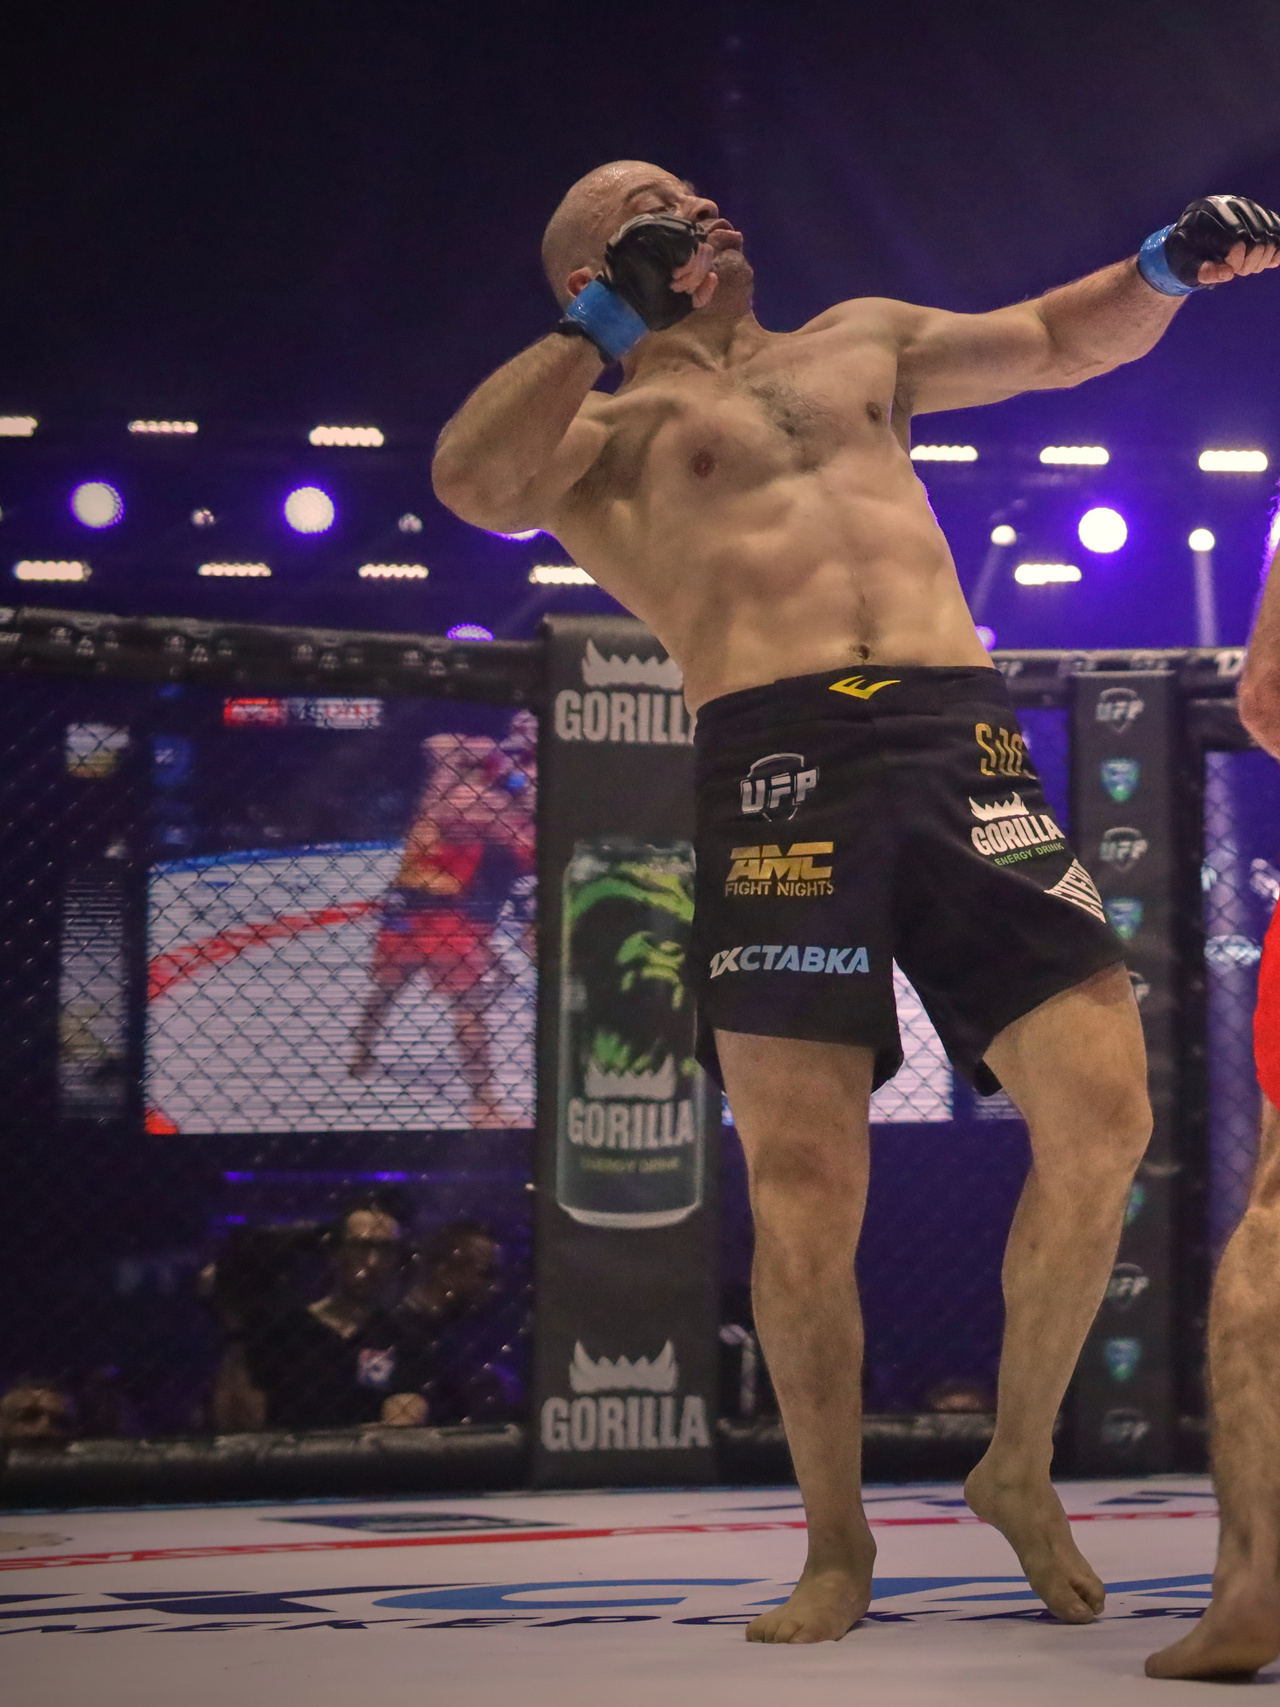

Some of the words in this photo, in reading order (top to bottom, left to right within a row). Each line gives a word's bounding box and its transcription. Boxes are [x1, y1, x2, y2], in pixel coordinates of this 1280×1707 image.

[554, 689, 698, 745] GORILL
[971, 815, 1066, 856] GORILLA
[994, 850, 1034, 867] ENERGY
[1034, 842, 1065, 857] DRINK
[726, 841, 834, 881] AMC
[725, 881, 772, 898] FIGHT
[776, 879, 834, 897] NIGHTS
[567, 1098, 695, 1150] GORILLA
[541, 1395, 711, 1451] GORILLA
